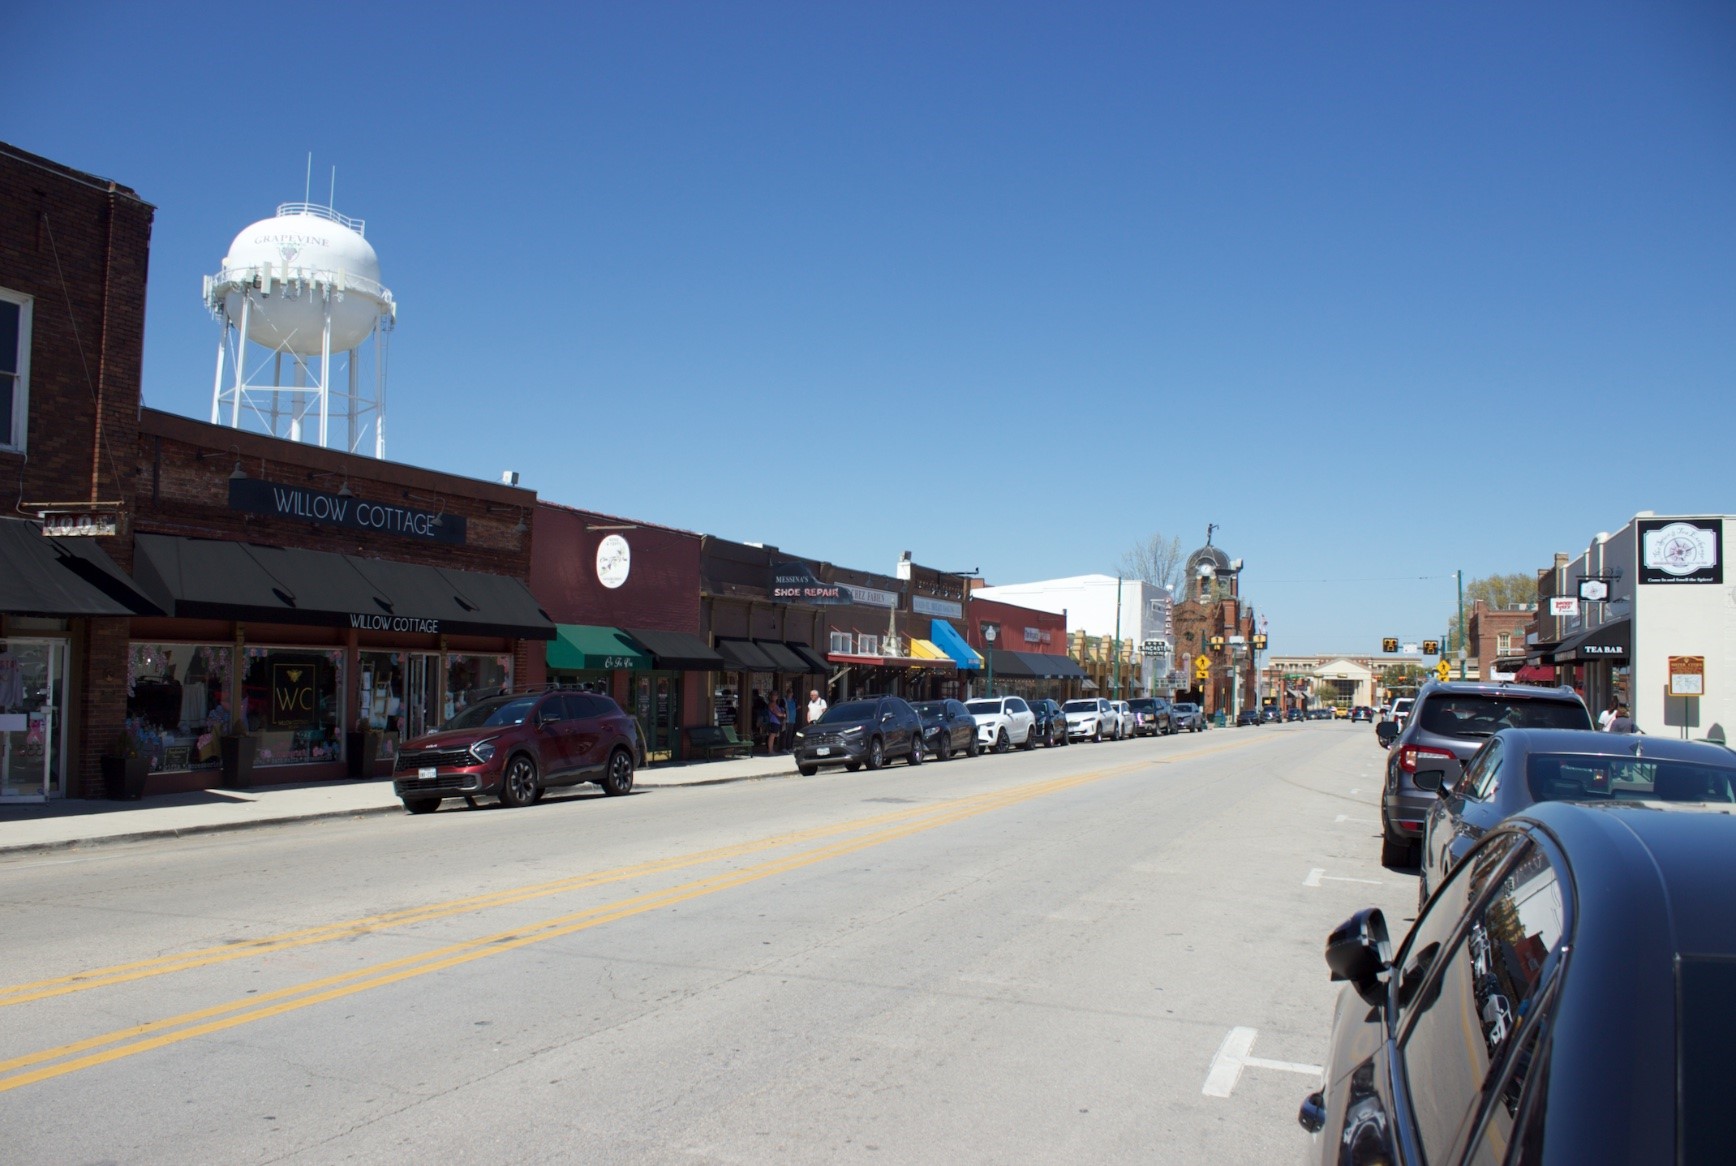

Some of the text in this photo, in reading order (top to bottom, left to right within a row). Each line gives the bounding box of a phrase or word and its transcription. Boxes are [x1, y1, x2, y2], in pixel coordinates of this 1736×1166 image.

[254, 234, 330, 248] GRAPEVINE
[273, 487, 436, 537] WILLOW COTTAGE
[775, 575, 809, 584] MESSINA'S
[774, 588, 839, 598] SHOE REPAIR
[867, 592, 885, 603] FABIEN
[350, 613, 439, 634] WILLOW COTTAGE
[276, 687, 313, 711] WC
